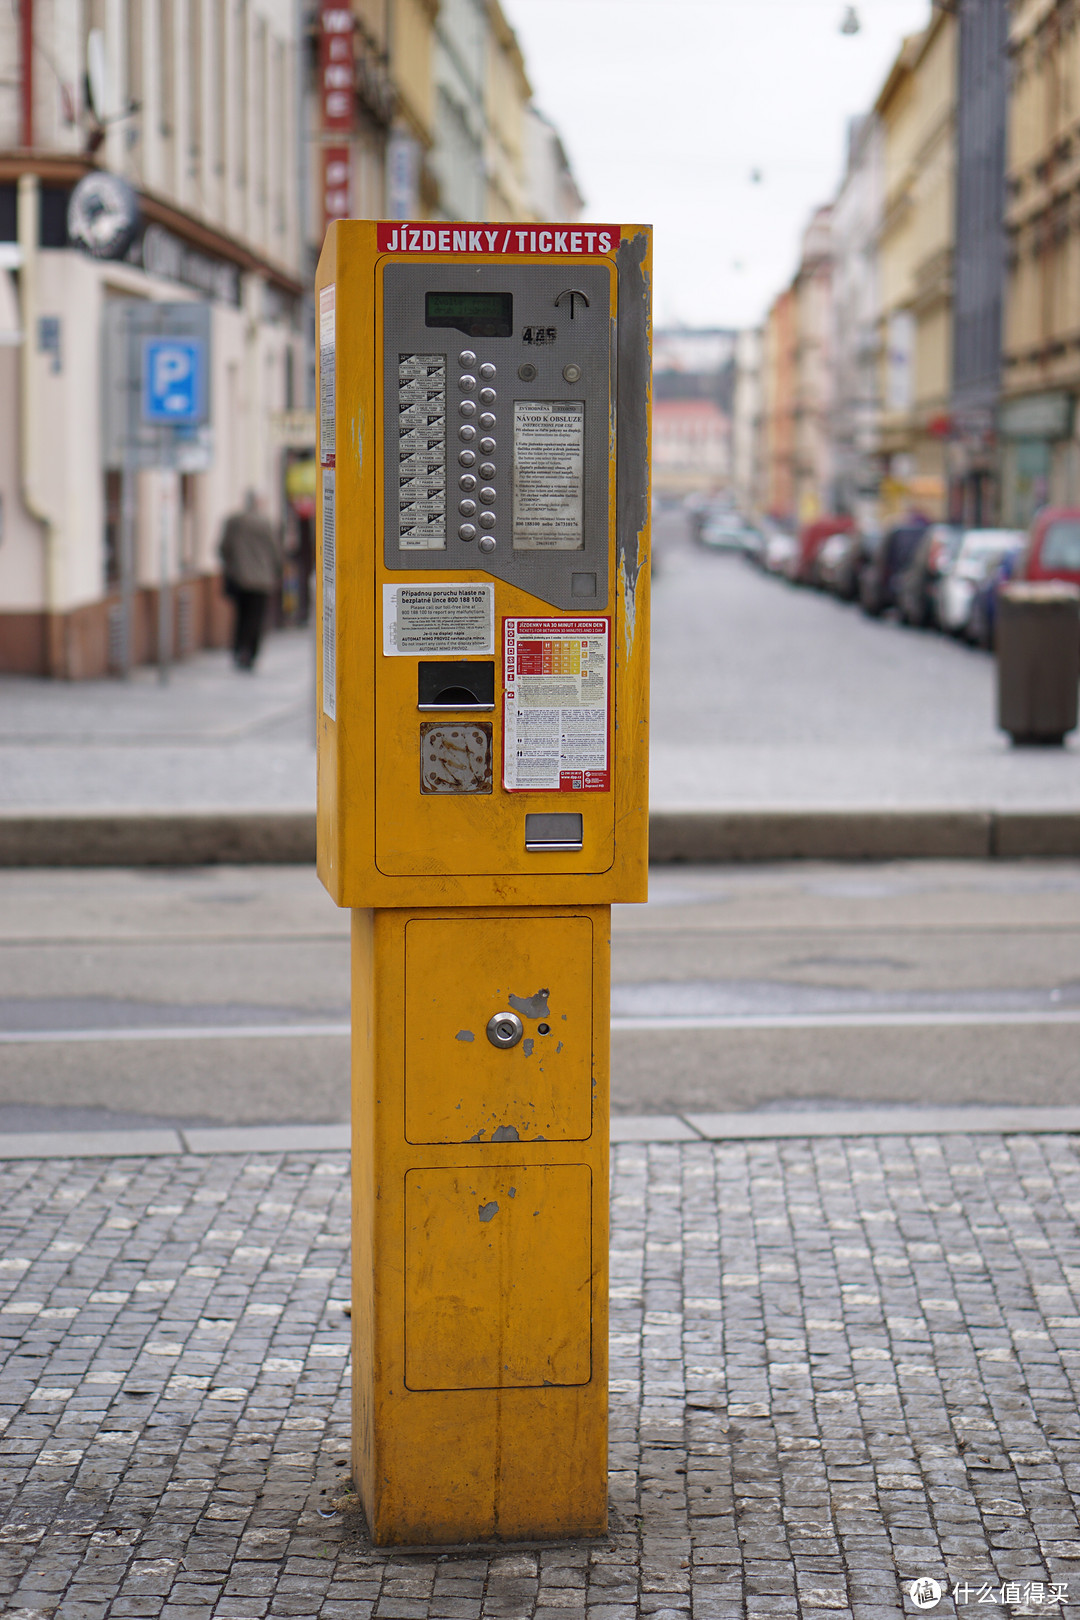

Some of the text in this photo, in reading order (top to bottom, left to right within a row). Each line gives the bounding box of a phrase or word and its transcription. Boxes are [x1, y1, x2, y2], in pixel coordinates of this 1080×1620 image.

[387, 224, 499, 251] JÍZDENKY
[515, 230, 612, 252] TICKETS
[155, 351, 188, 393] P
[516, 414, 541, 422] NÁVOD
